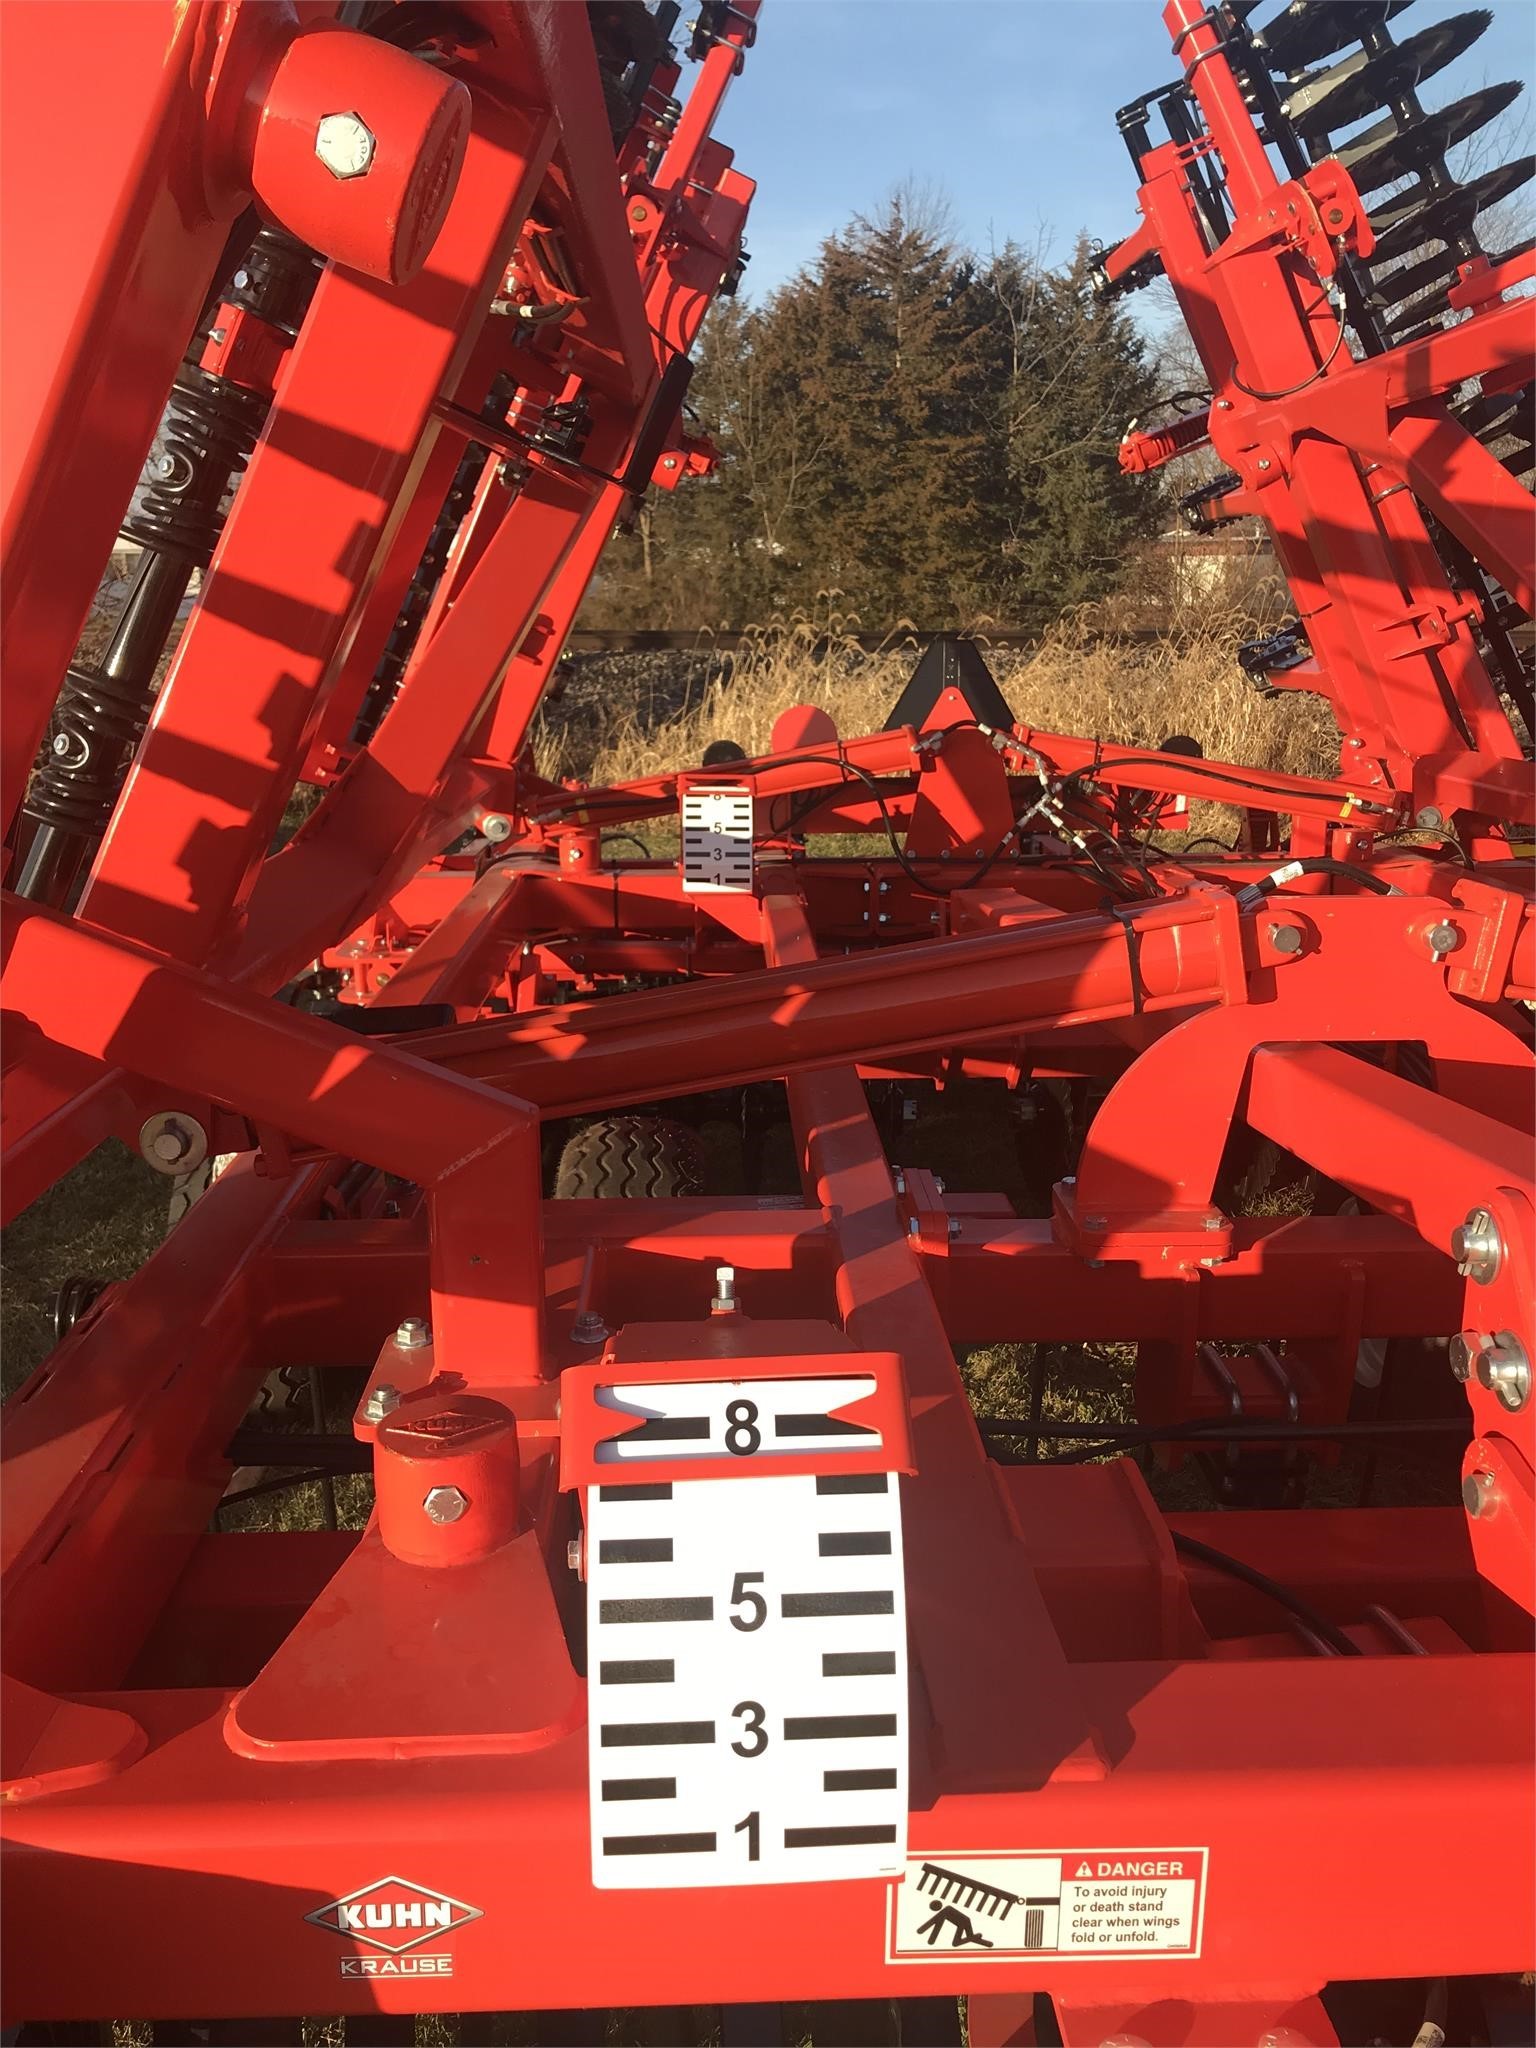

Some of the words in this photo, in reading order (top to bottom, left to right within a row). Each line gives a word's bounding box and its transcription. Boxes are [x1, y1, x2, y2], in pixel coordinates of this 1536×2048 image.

[714, 822, 722, 835] 5
[713, 848, 722, 861] 3
[714, 873, 720, 886] 1
[725, 1399, 761, 1456] 8
[729, 1571, 767, 1633] 5
[730, 1700, 769, 1758] 3
[734, 1811, 760, 1862] 1
[1097, 1861, 1183, 1877] DANGER
[1074, 1886, 1090, 1897] To
[1093, 1885, 1128, 1897] avoid
[1131, 1885, 1167, 1899] injury
[1073, 1903, 1086, 1912] or
[1090, 1901, 1124, 1912] death
[1128, 1900, 1163, 1912] stand
[337, 1903, 451, 1929] KUHN
[1072, 1917, 1103, 1928] clear
[1106, 1916, 1139, 1927] when
[1143, 1916, 1180, 1929] wings
[1071, 1932, 1095, 1943] fold
[1098, 1934, 1112, 1943] or
[1115, 1931, 1158, 1942] unfold.
[341, 1959, 453, 1975] KRAUSE
